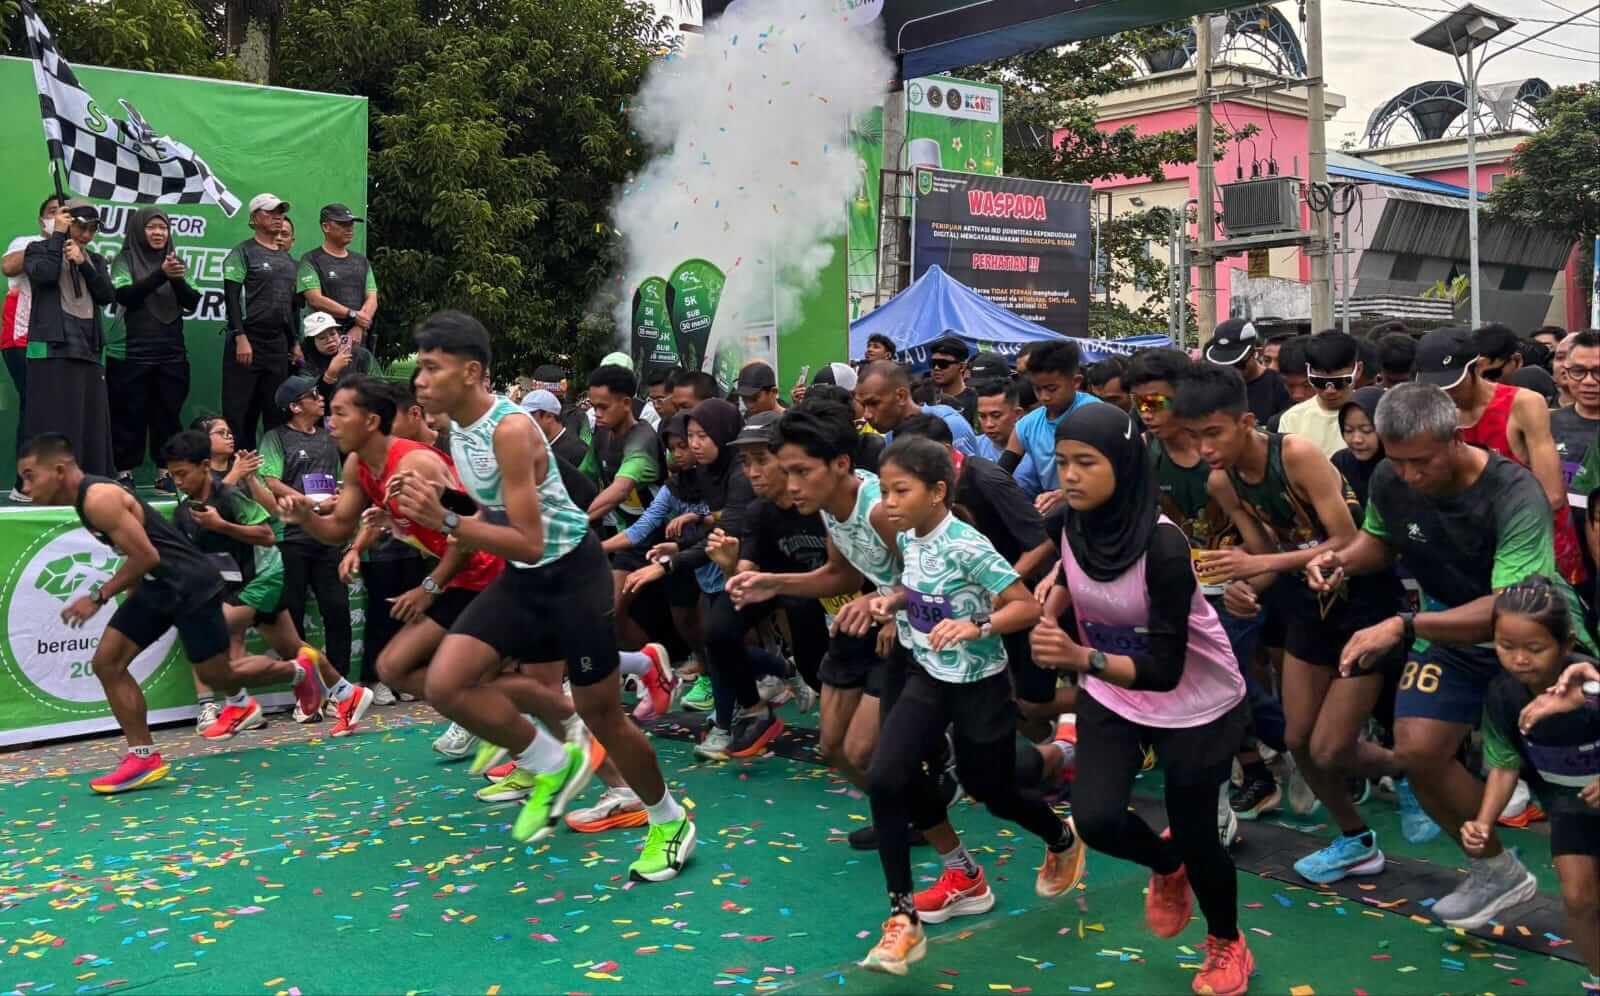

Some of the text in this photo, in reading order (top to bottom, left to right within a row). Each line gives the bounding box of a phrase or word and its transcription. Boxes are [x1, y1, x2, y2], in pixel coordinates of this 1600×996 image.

[968, 190, 1047, 220] WASPADA
[168, 216, 205, 235] FOR
[963, 225, 990, 233] AKTIVASI
[972, 253, 1027, 272] PERHATIAN
[684, 296, 697, 306] 5K
[686, 309, 700, 318] SUB
[691, 317, 708, 328] menit
[37, 637, 98, 655] berauc
[1399, 661, 1442, 693] 86
